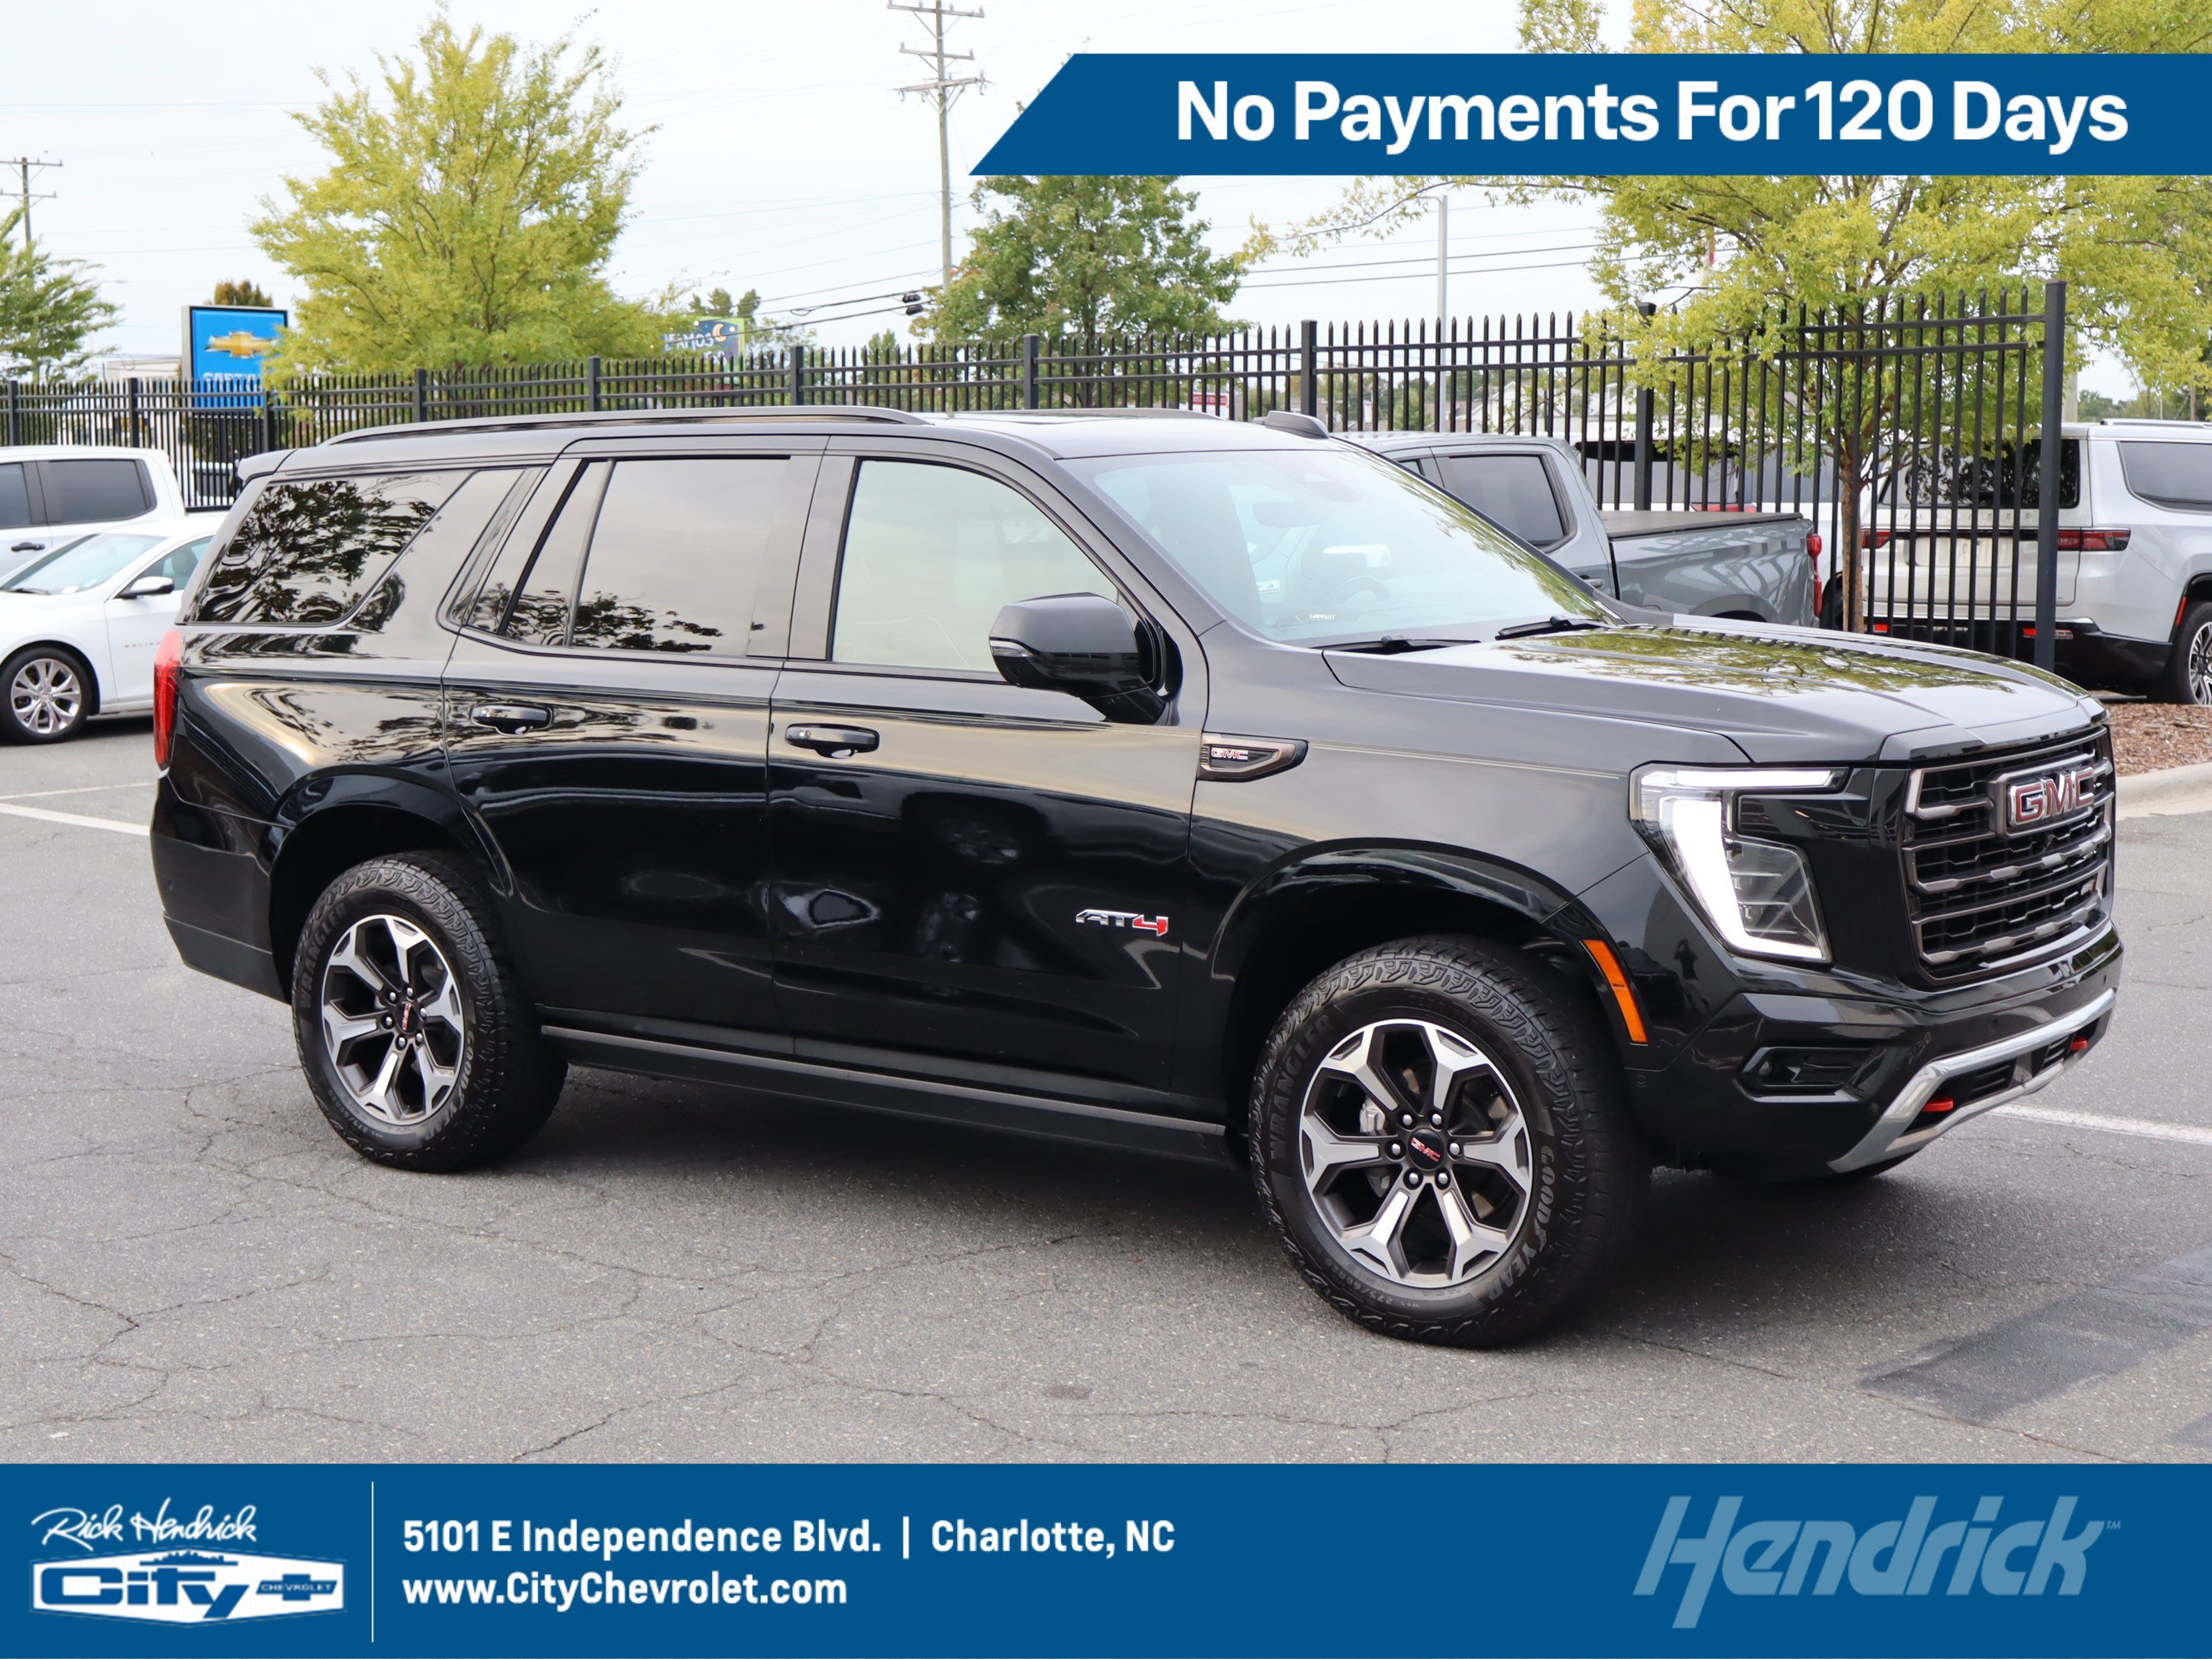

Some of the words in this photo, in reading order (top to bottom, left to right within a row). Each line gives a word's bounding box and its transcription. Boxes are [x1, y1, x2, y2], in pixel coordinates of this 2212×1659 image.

[1211, 747, 1249, 760] GMC
[2010, 766, 2094, 825] GMC
[1075, 909, 1169, 937] AT4
[1269, 1014, 1333, 1159] WRANGLER
[1410, 1137, 1441, 1163] GMC
